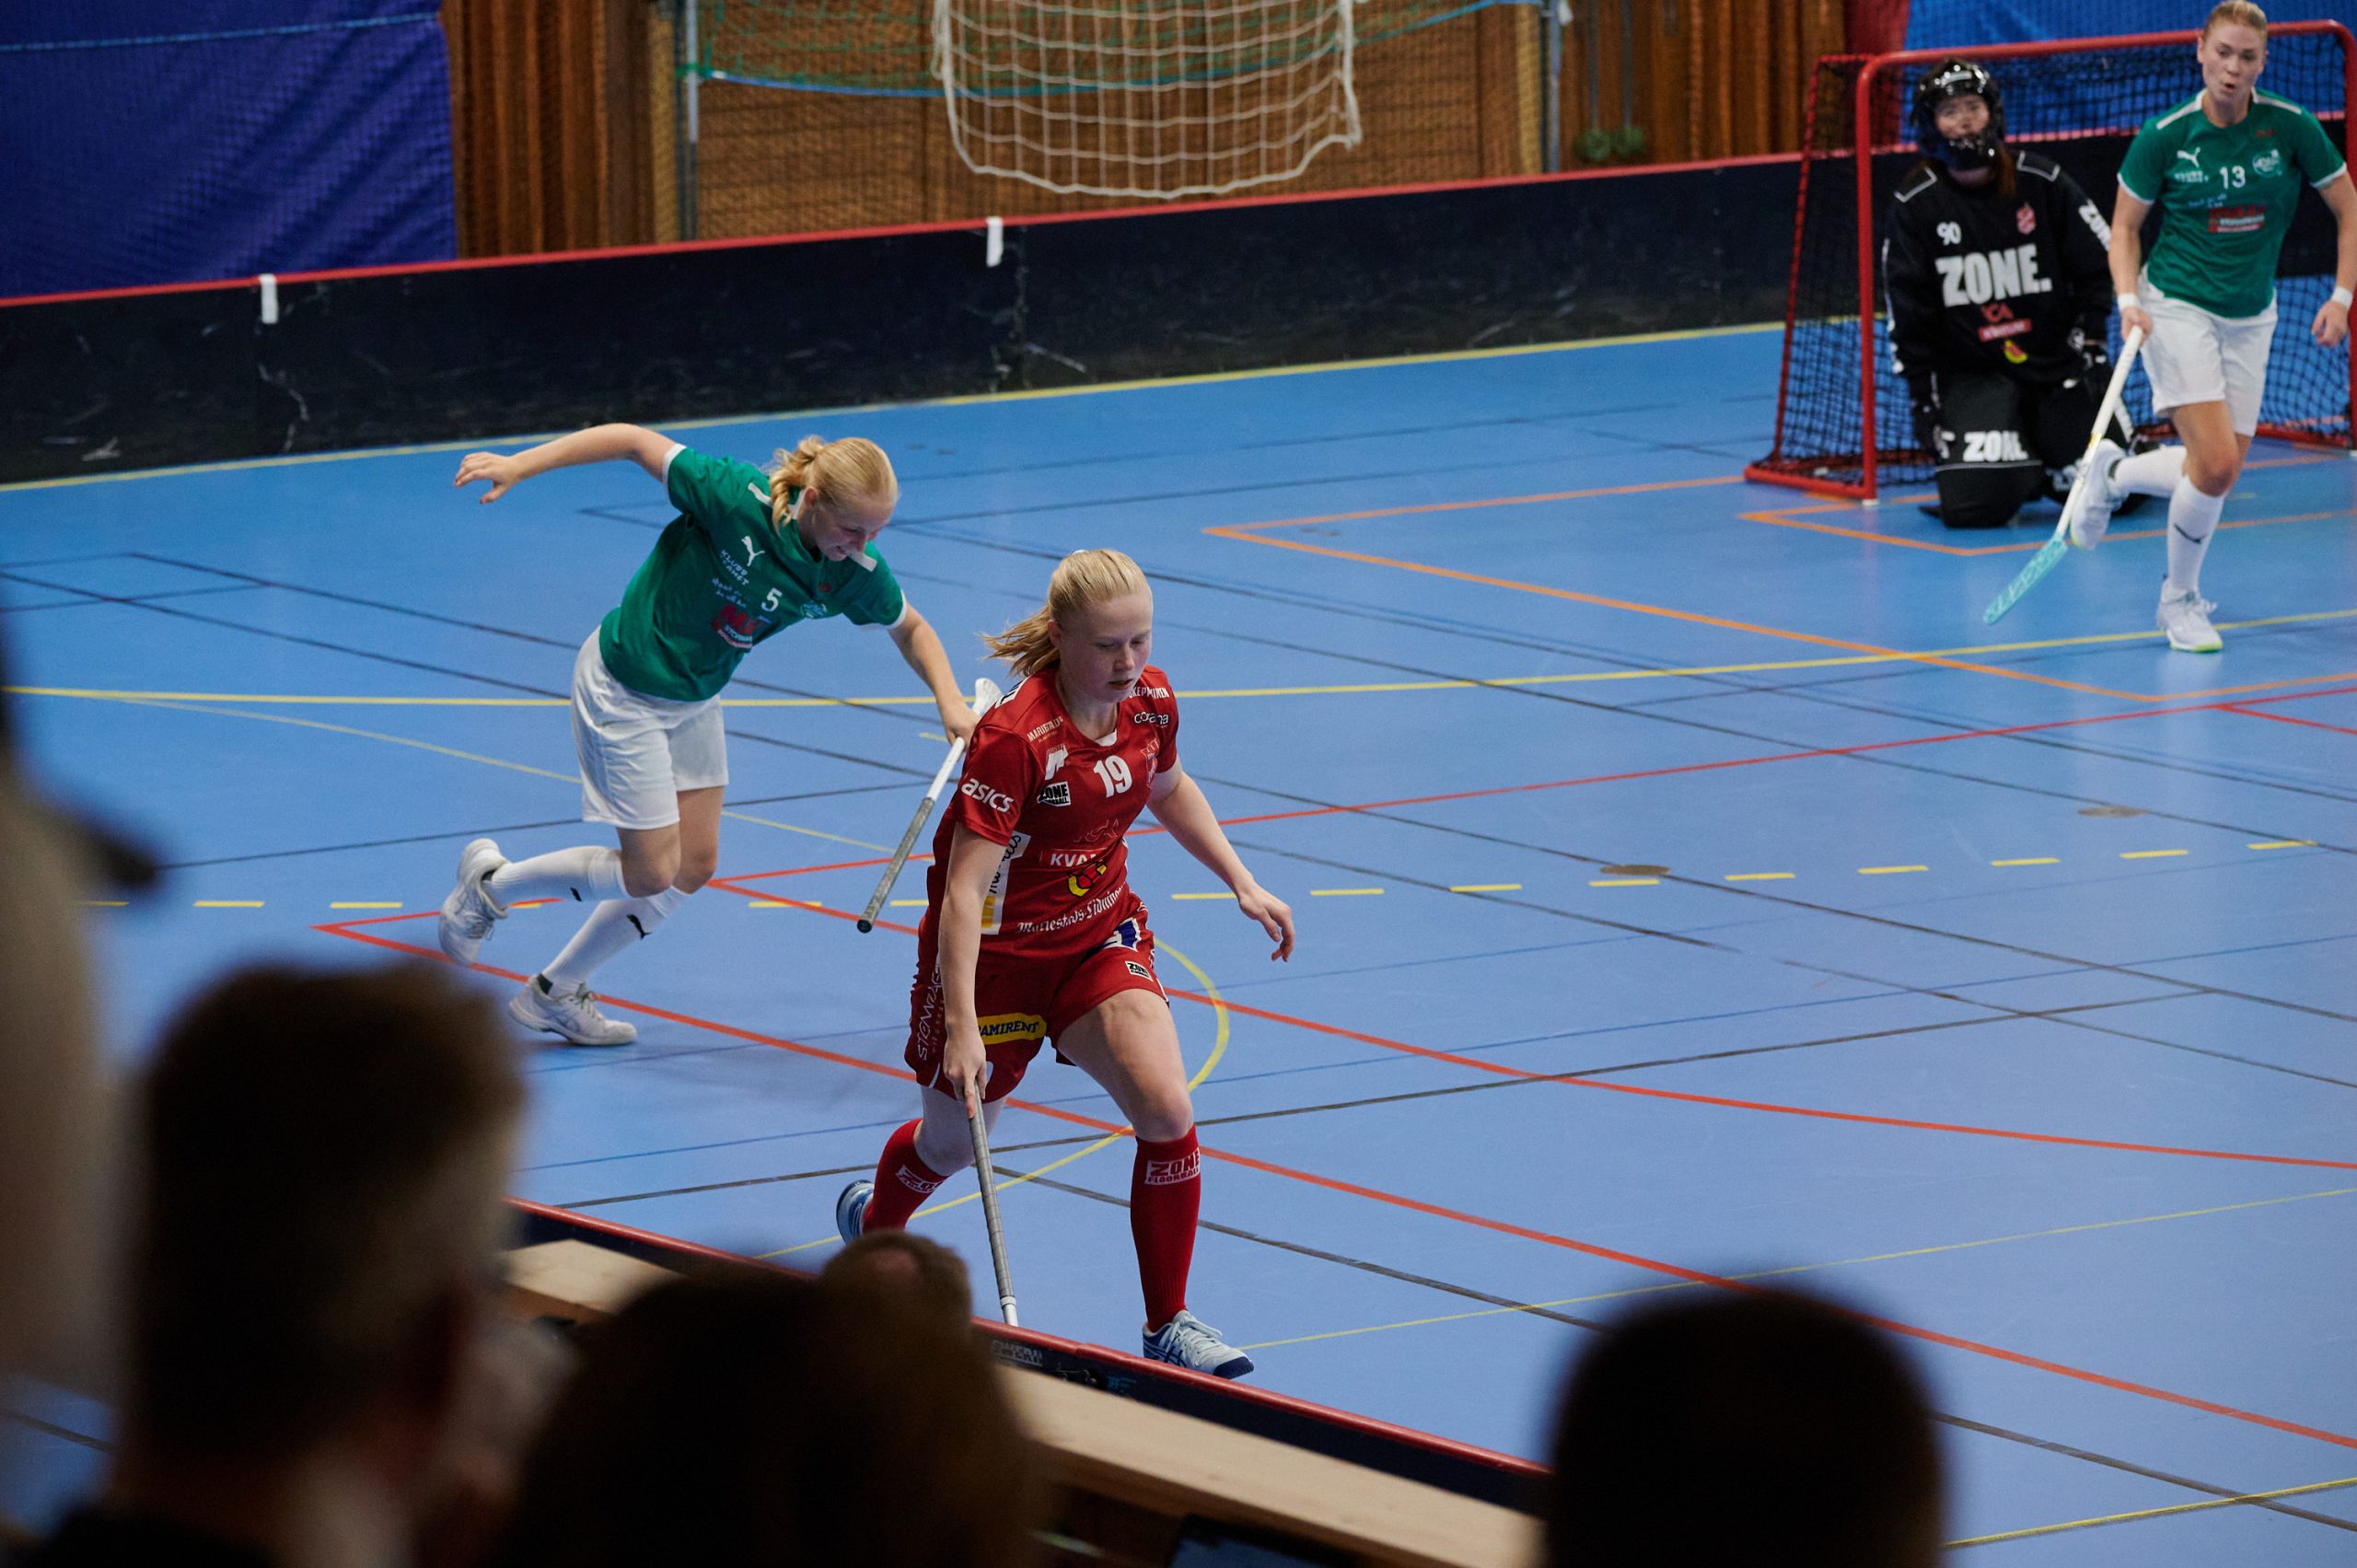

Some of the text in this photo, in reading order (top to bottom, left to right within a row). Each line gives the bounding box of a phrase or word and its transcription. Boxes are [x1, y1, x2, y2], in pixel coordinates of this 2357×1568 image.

[2219, 165, 2247, 190] 13
[1936, 221, 1962, 246] 90
[1935, 243, 2053, 308] ZONE.
[761, 587, 783, 612] 5
[1093, 754, 1133, 798] 19
[960, 778, 1015, 814] asics
[1050, 853, 1097, 867] KVA
